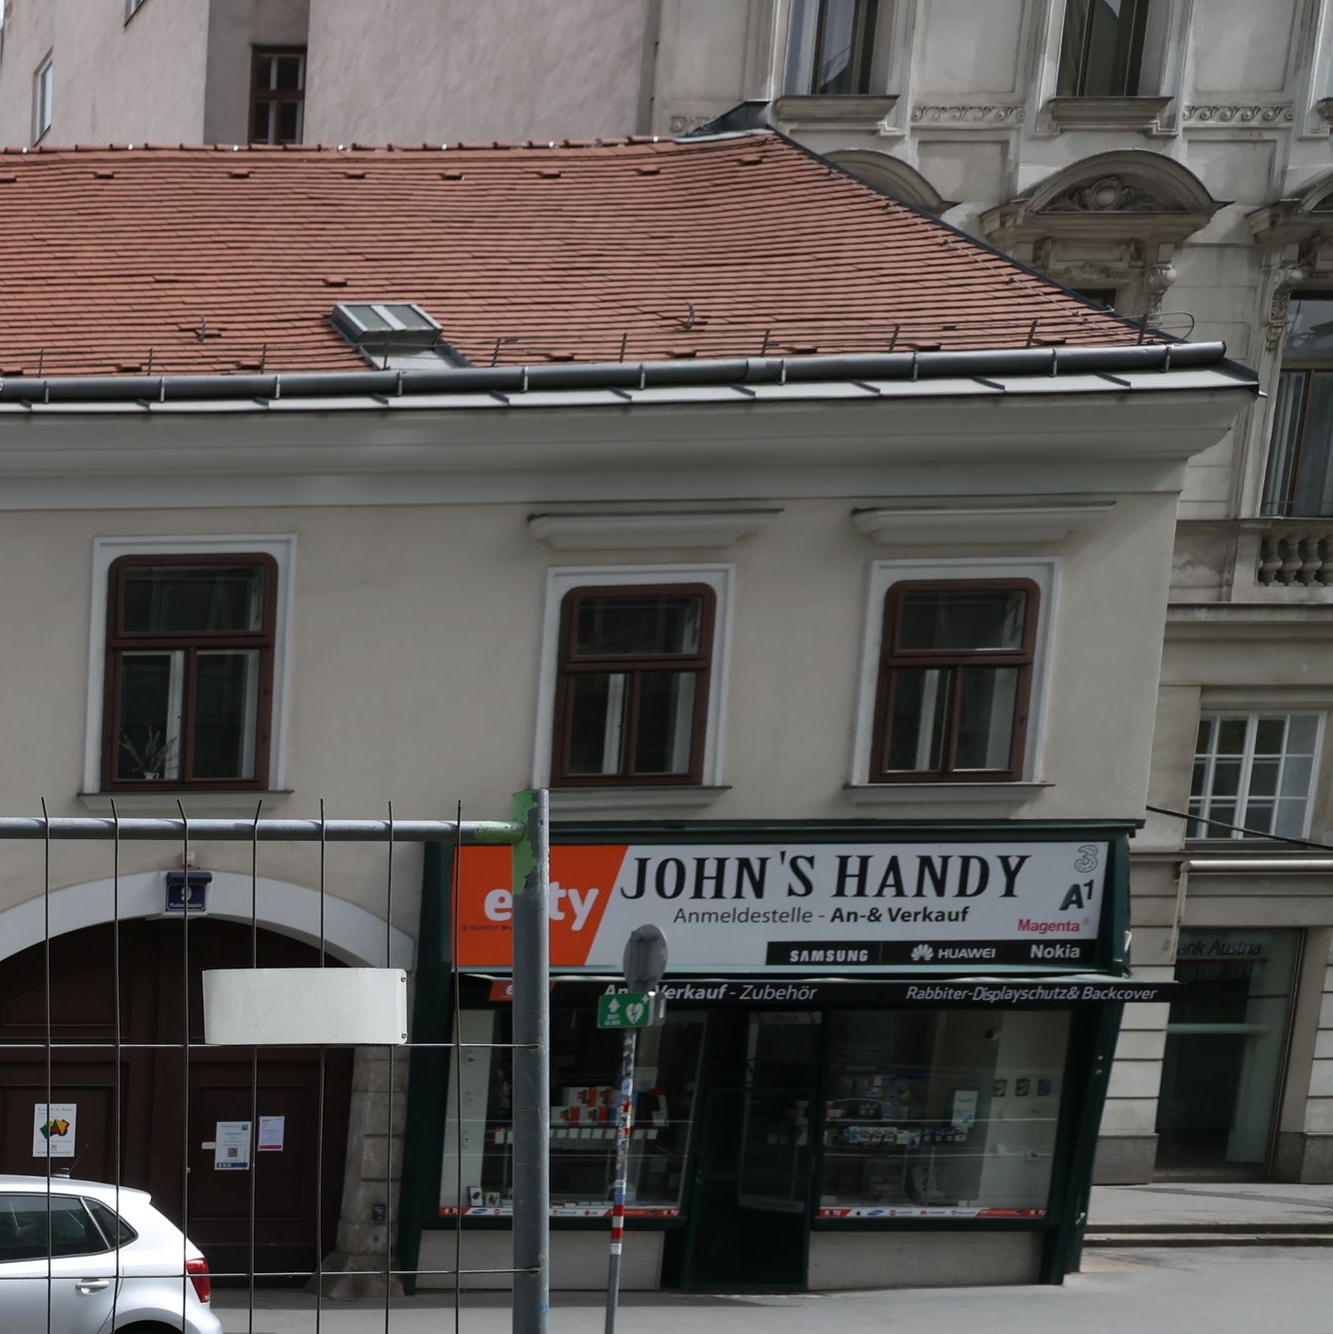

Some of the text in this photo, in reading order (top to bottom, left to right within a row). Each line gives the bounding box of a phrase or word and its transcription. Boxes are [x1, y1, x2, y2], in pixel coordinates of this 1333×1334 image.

[620, 851, 1032, 899] JOHN'S HANDY
[485, 881, 599, 931] ety
[674, 906, 813, 925] Anmeldestelle
[888, 906, 970, 923] Verkauf
[1017, 918, 1081, 933] Magenta
[789, 945, 1081, 963] SAMSUNG HUAWEI Nokia
[1208, 938, 1263, 956] Austria
[739, 984, 818, 1000] Zubehör
[1083, 986, 1158, 1000] Backcover
